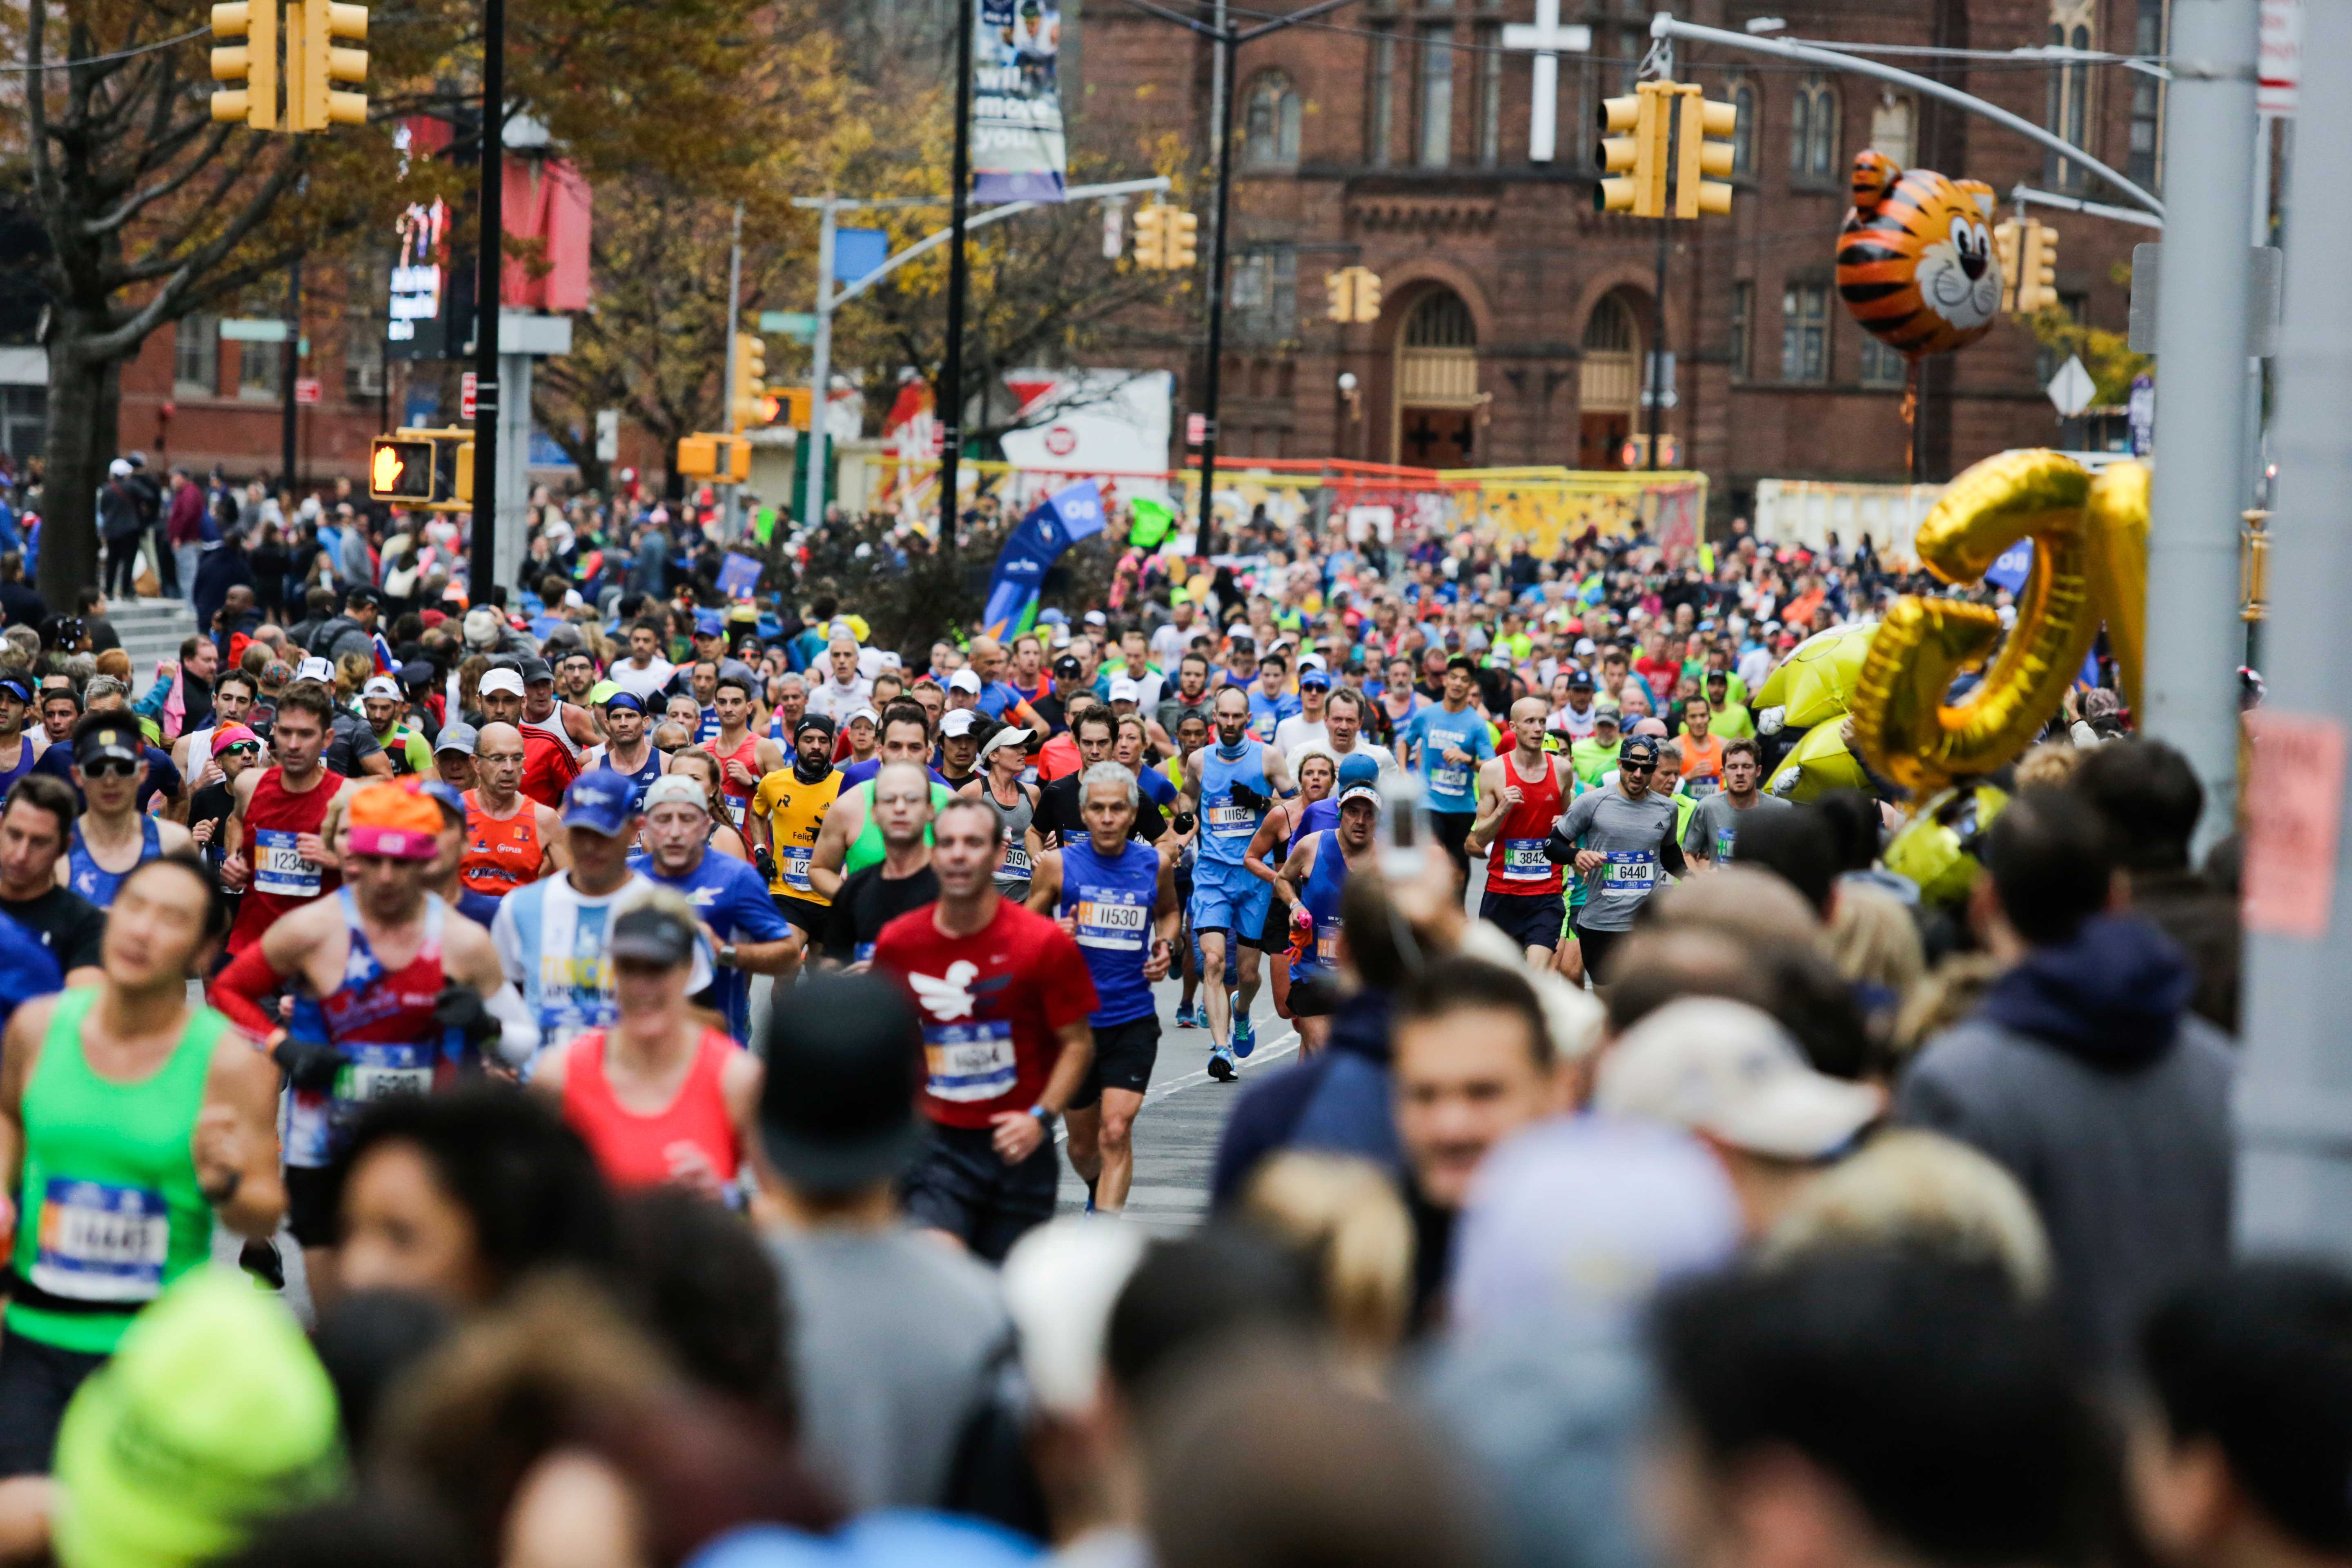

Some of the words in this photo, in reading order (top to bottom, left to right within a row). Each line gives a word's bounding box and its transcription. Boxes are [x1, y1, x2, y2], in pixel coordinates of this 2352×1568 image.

[1225, 808, 1248, 821] 11162
[793, 831, 813, 842] Felip
[497, 843, 522, 854] WEPLER
[1005, 850, 1026, 866] 6191
[1520, 852, 1545, 864] 3842
[795, 861, 811, 874] 127
[1620, 865, 1646, 879] 6440
[1100, 907, 1138, 927] 11530
